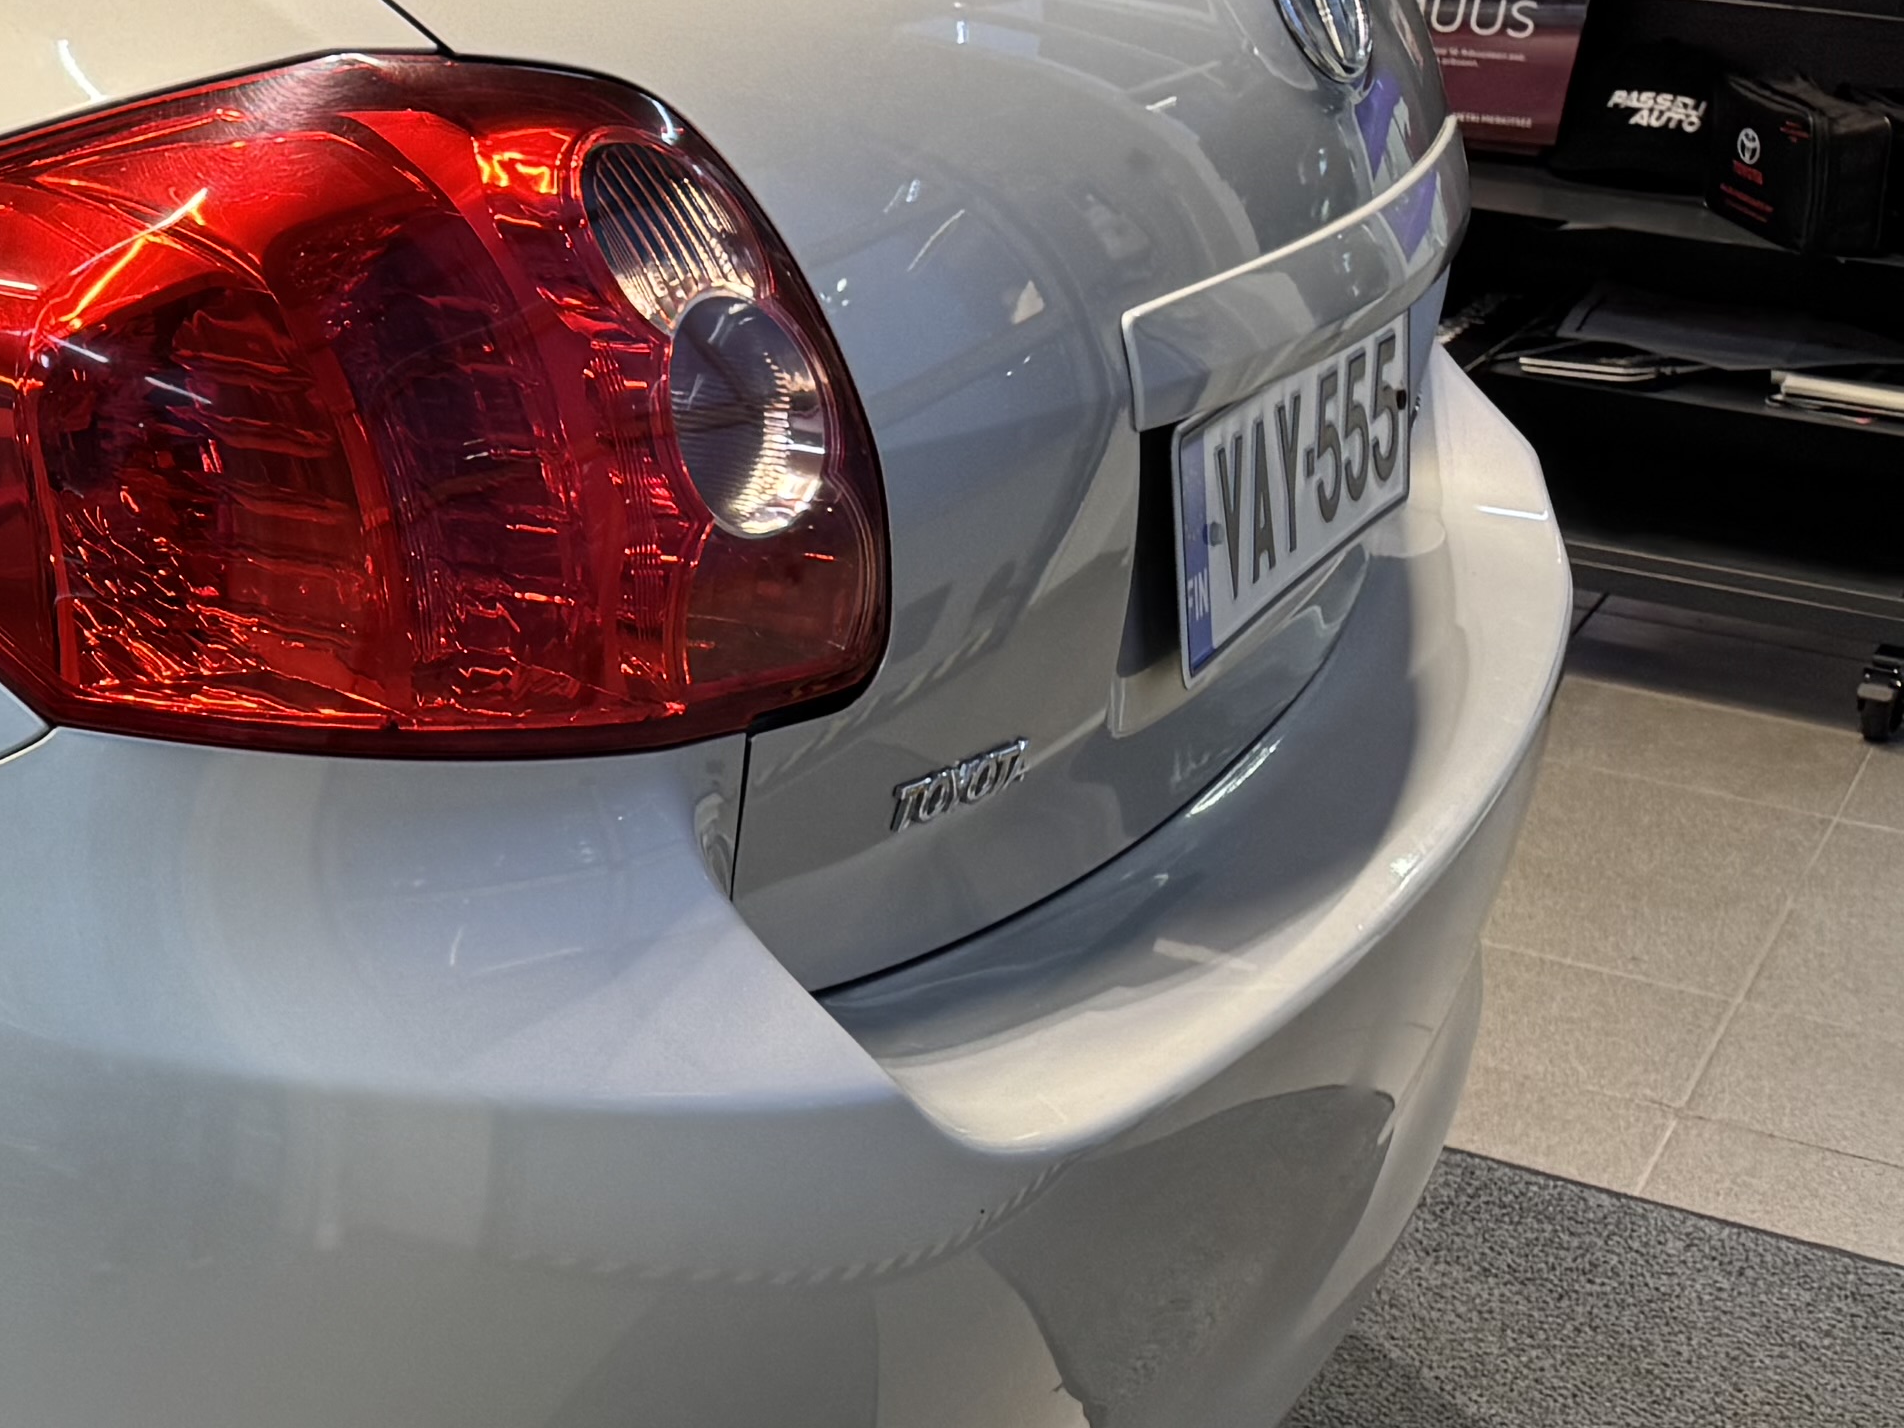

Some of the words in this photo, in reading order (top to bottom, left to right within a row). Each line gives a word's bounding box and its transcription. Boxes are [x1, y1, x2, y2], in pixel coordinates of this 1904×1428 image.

[1628, 108, 1701, 133] AUTO
[1213, 330, 1401, 602] VAY-555
[1187, 566, 1211, 623] FIN
[890, 735, 1030, 834] TOYOTA
